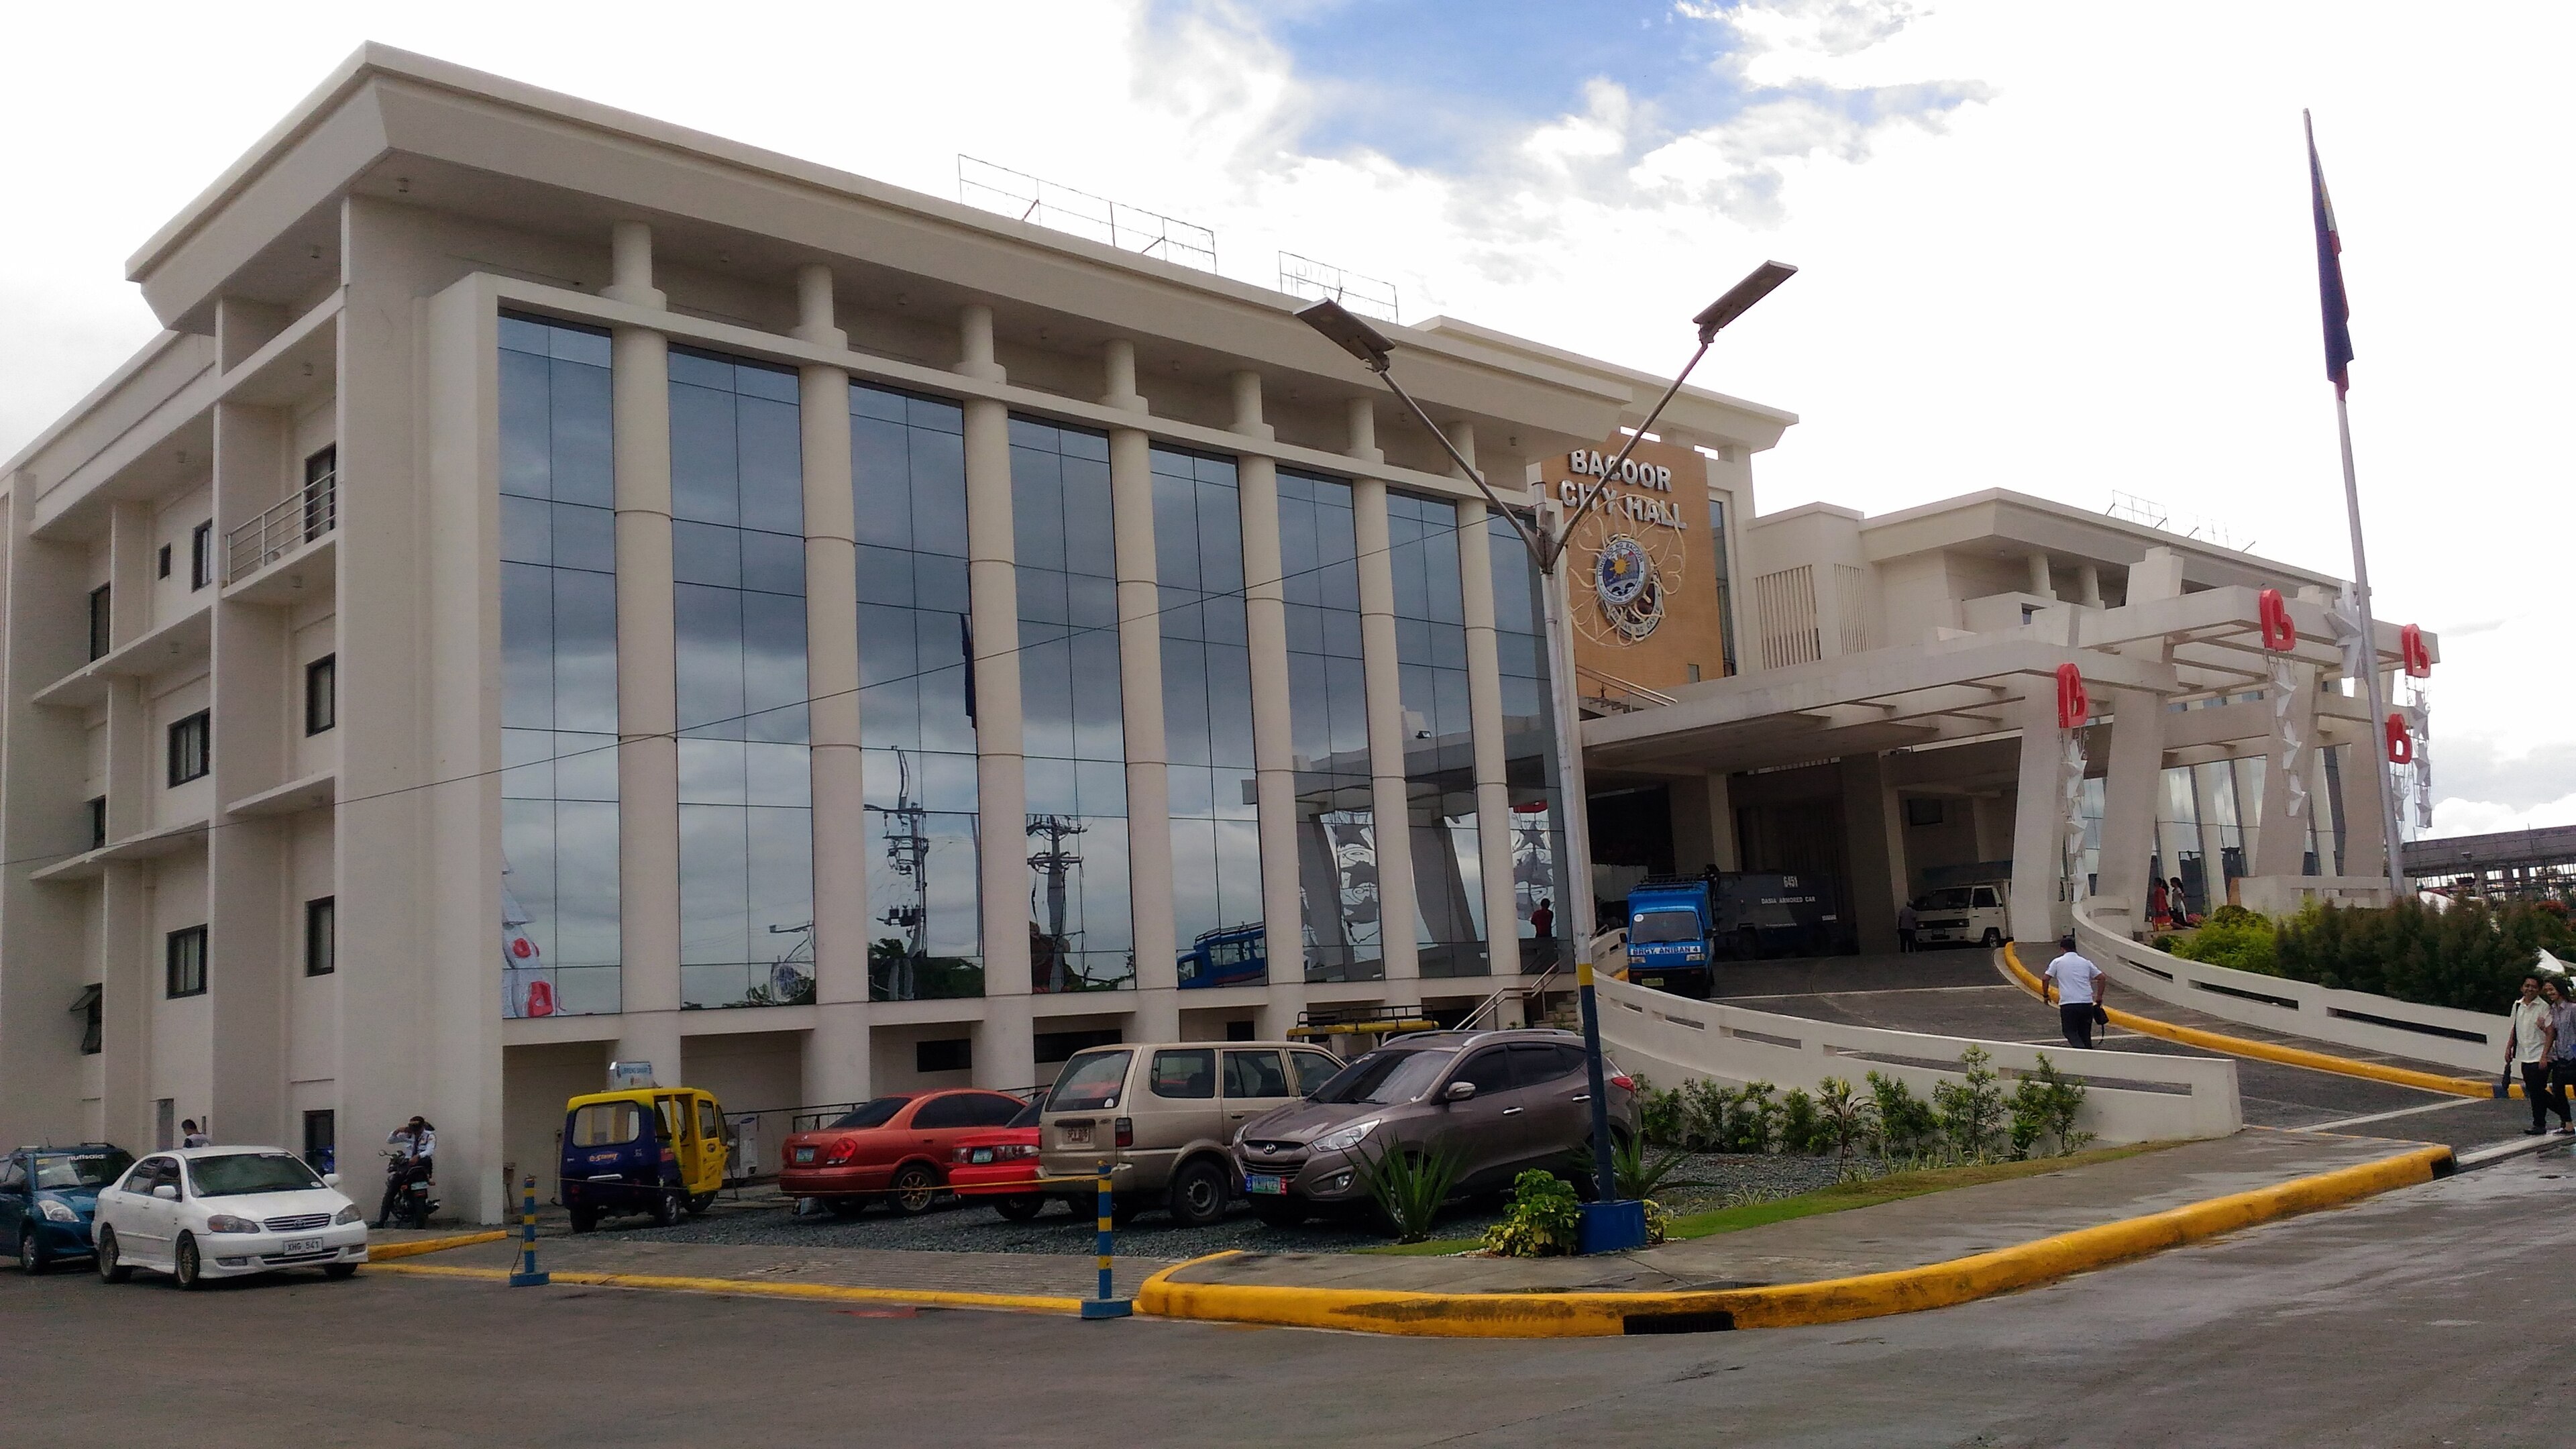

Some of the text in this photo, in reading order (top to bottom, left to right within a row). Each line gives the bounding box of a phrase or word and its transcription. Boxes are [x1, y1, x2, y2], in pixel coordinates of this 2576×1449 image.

[1569, 449, 1672, 492] BACOOR
[1560, 479, 1687, 529] CITY HALL
[1783, 875, 1798, 888] 6451
